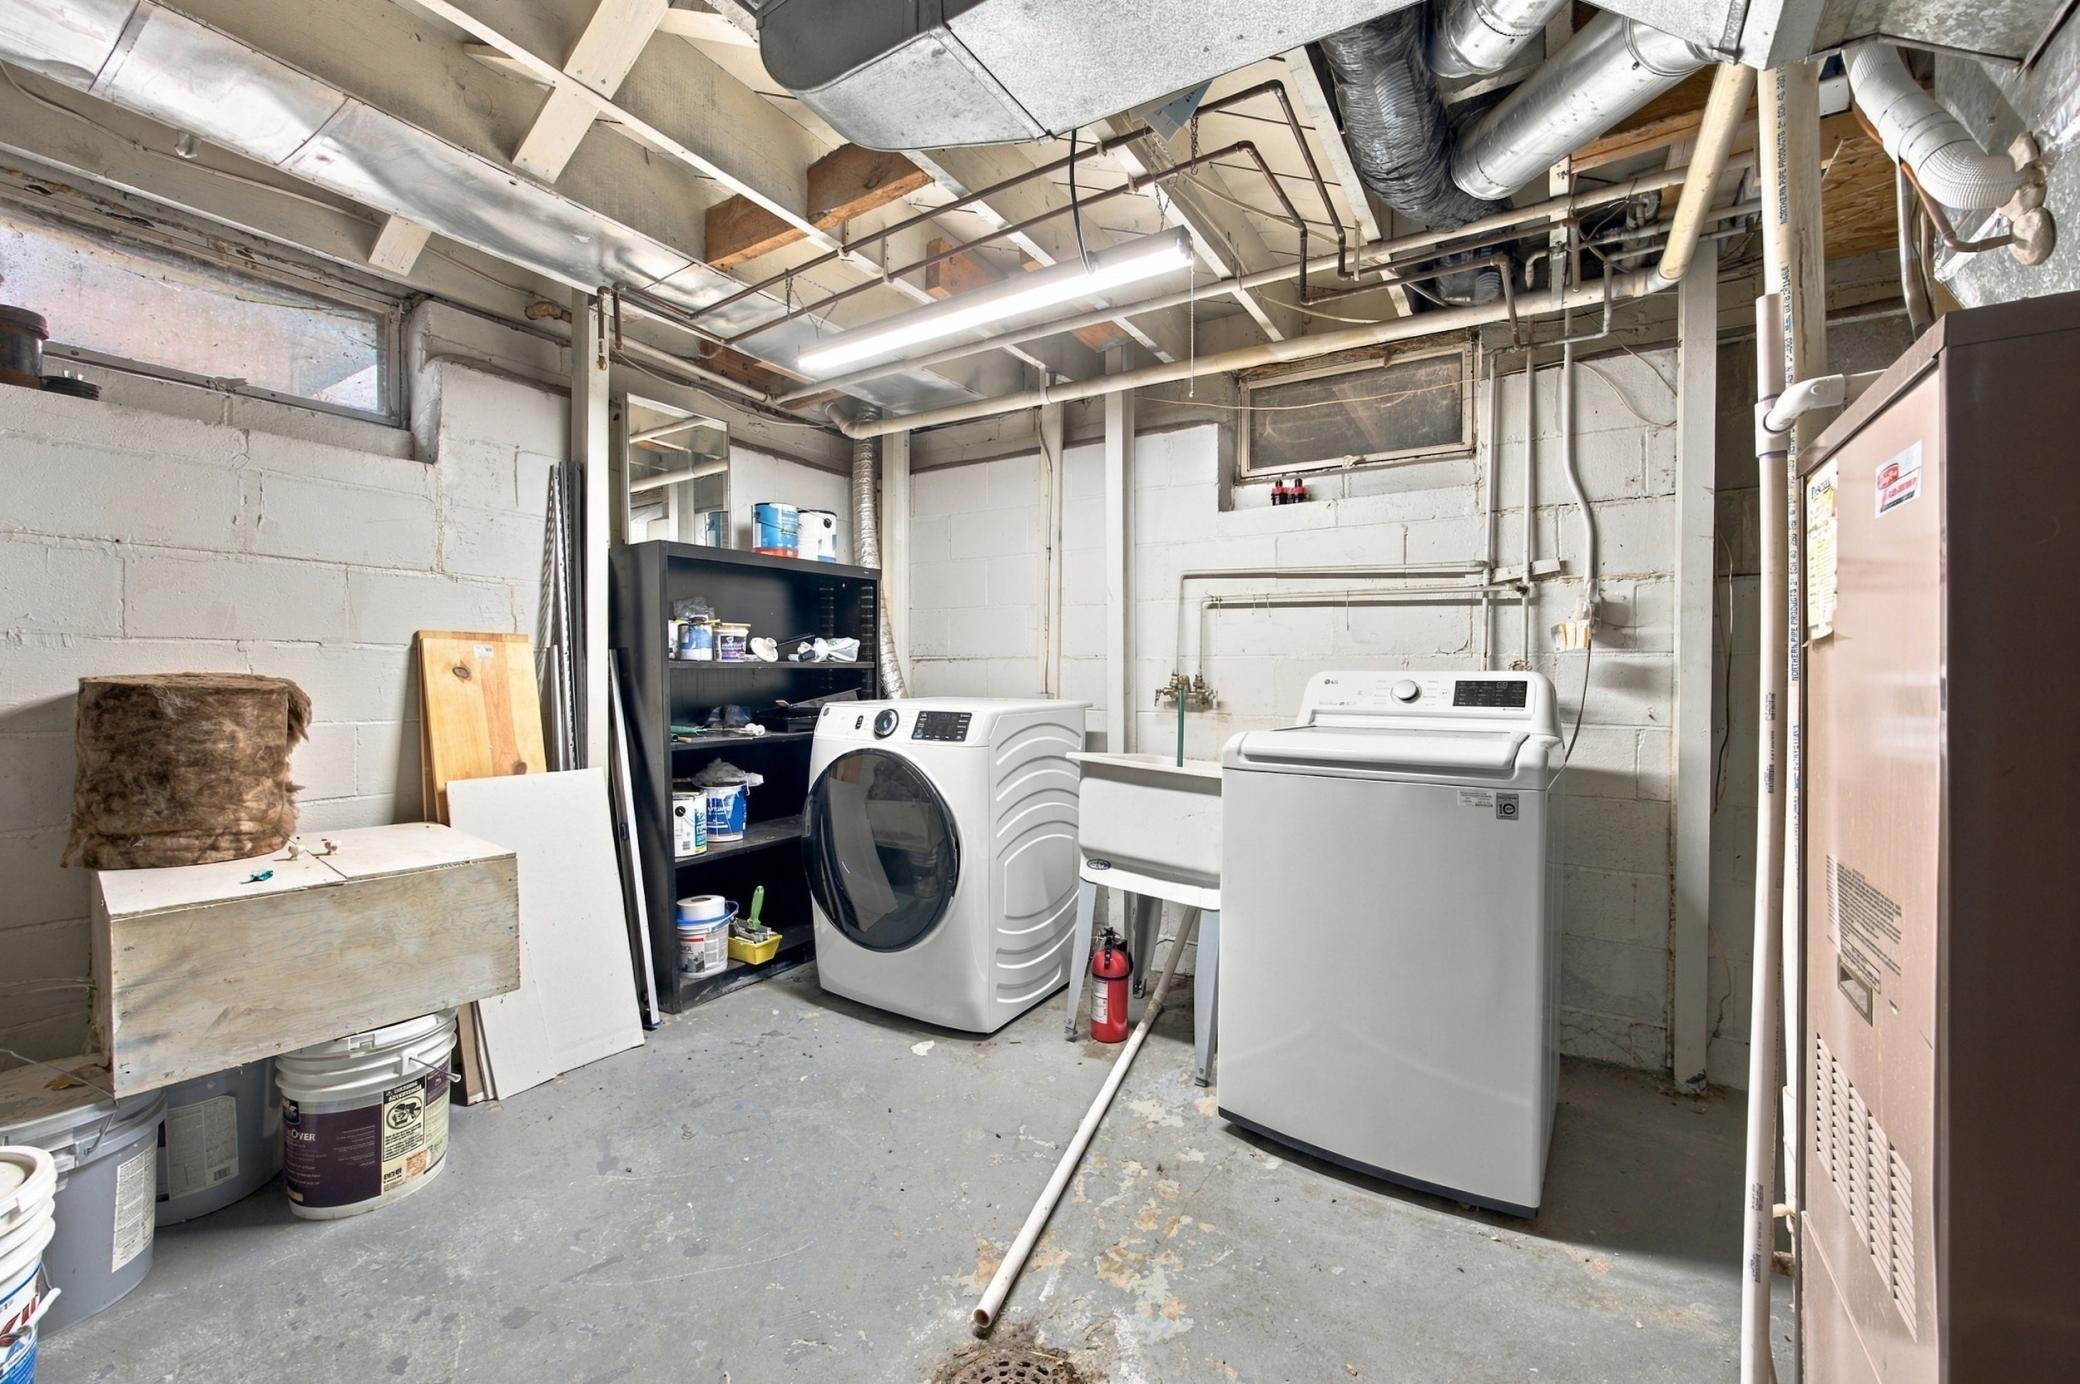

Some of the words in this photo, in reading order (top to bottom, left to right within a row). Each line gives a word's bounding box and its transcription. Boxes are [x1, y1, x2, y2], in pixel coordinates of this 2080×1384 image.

[1777, 130, 1787, 168] PRODUCTS
[1778, 168, 1787, 185] PIPE
[1779, 184, 1788, 224] NORTHERN
[1790, 588, 1798, 625] PRODUCTS
[1790, 626, 1799, 642] PIPE
[1790, 643, 1799, 681] NORTHERN
